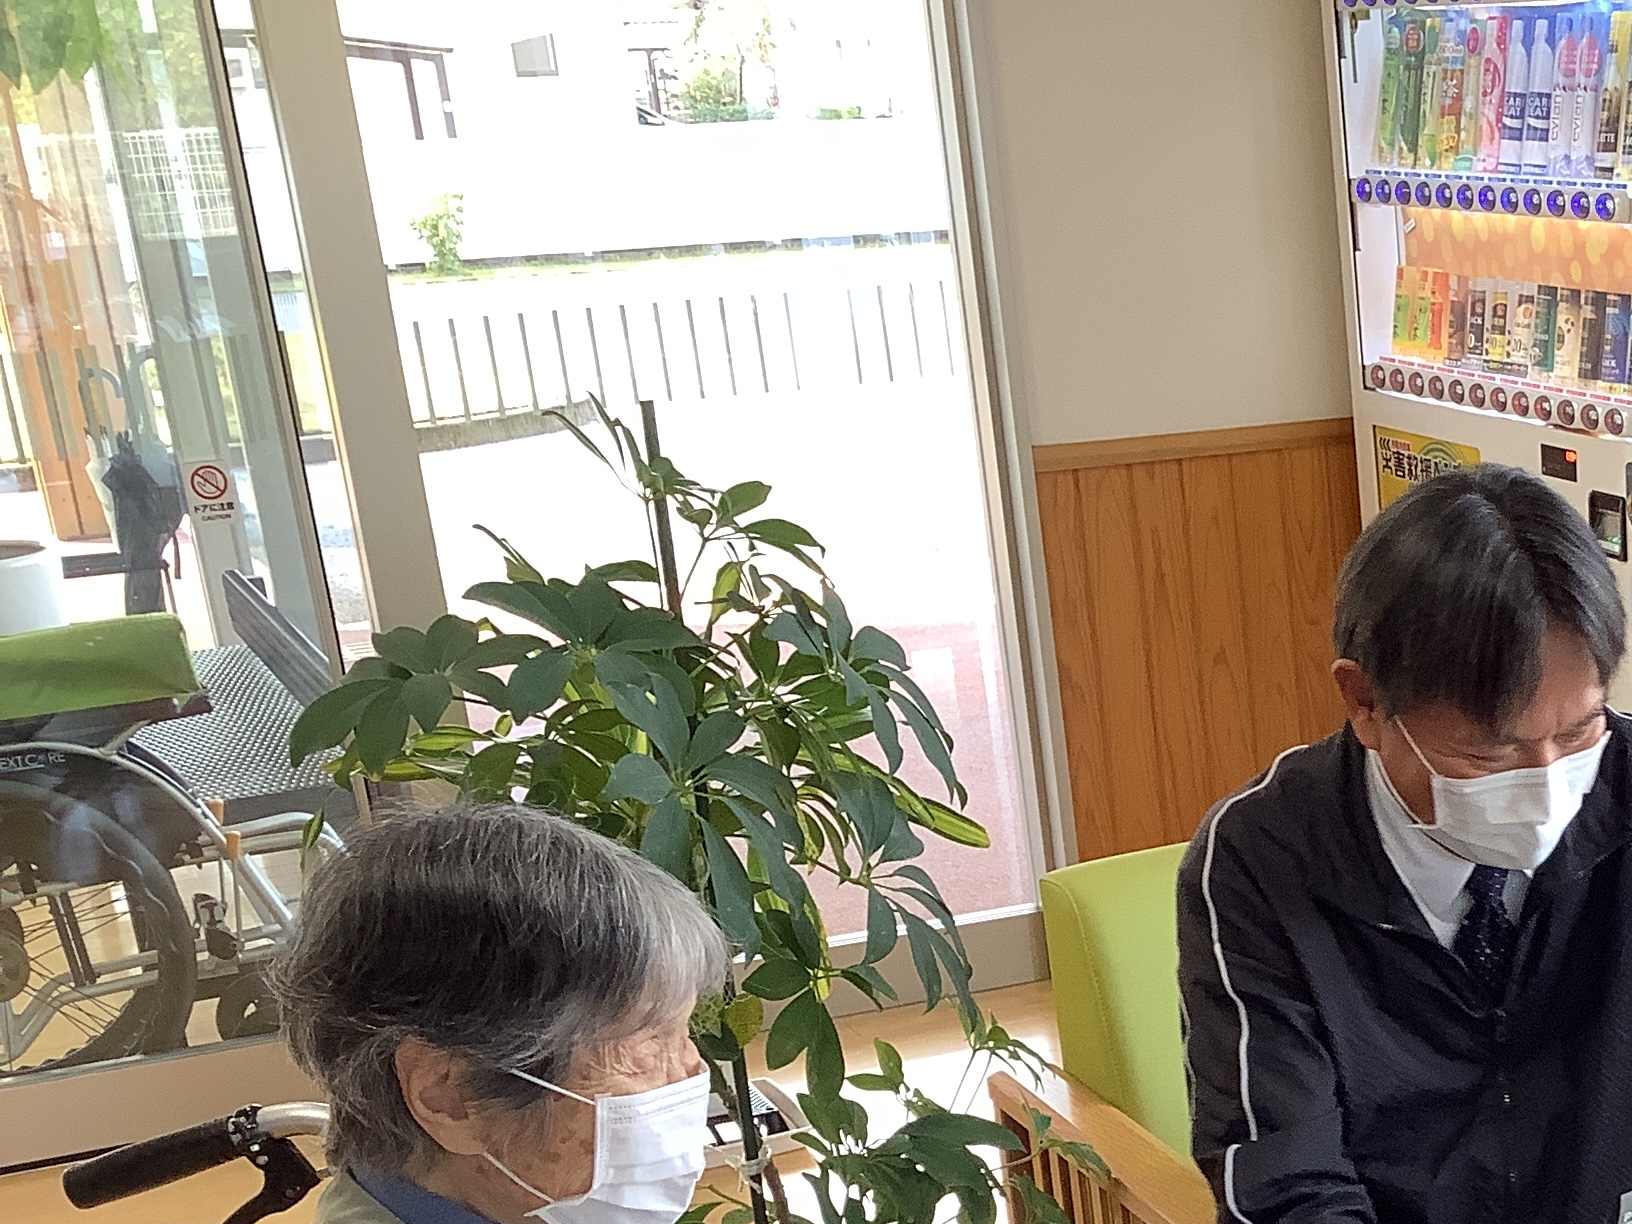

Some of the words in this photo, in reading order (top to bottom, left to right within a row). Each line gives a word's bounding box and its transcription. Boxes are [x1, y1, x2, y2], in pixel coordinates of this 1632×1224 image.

[194, 502, 235, 513] ドアに注意
